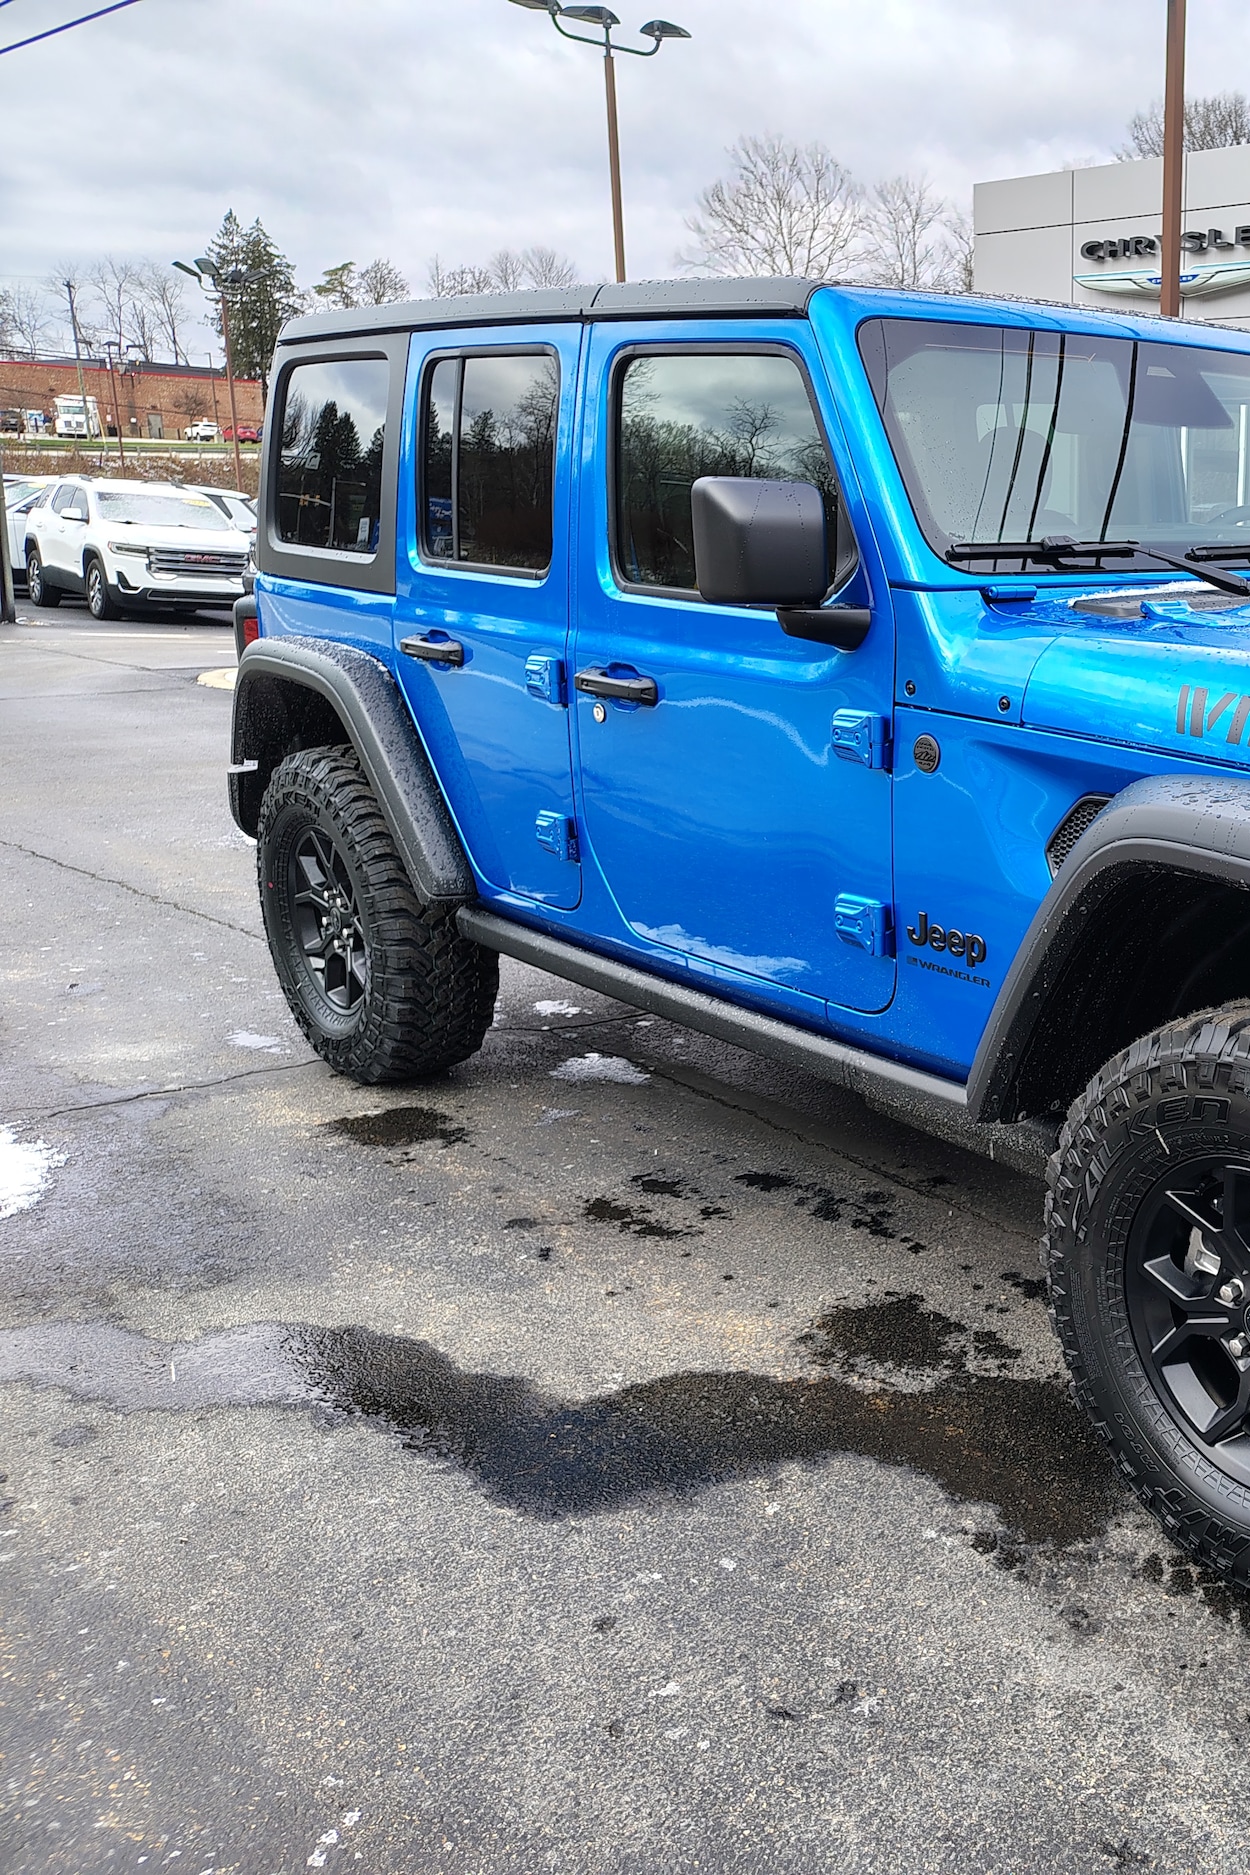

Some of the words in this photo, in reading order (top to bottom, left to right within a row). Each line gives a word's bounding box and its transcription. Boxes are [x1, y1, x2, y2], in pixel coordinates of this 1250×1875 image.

[184, 553, 220, 564] GMC
[906, 911, 987, 968] Jeep
[917, 958, 991, 989] WRANGLER
[1071, 1095, 1231, 1246] FALKEN
